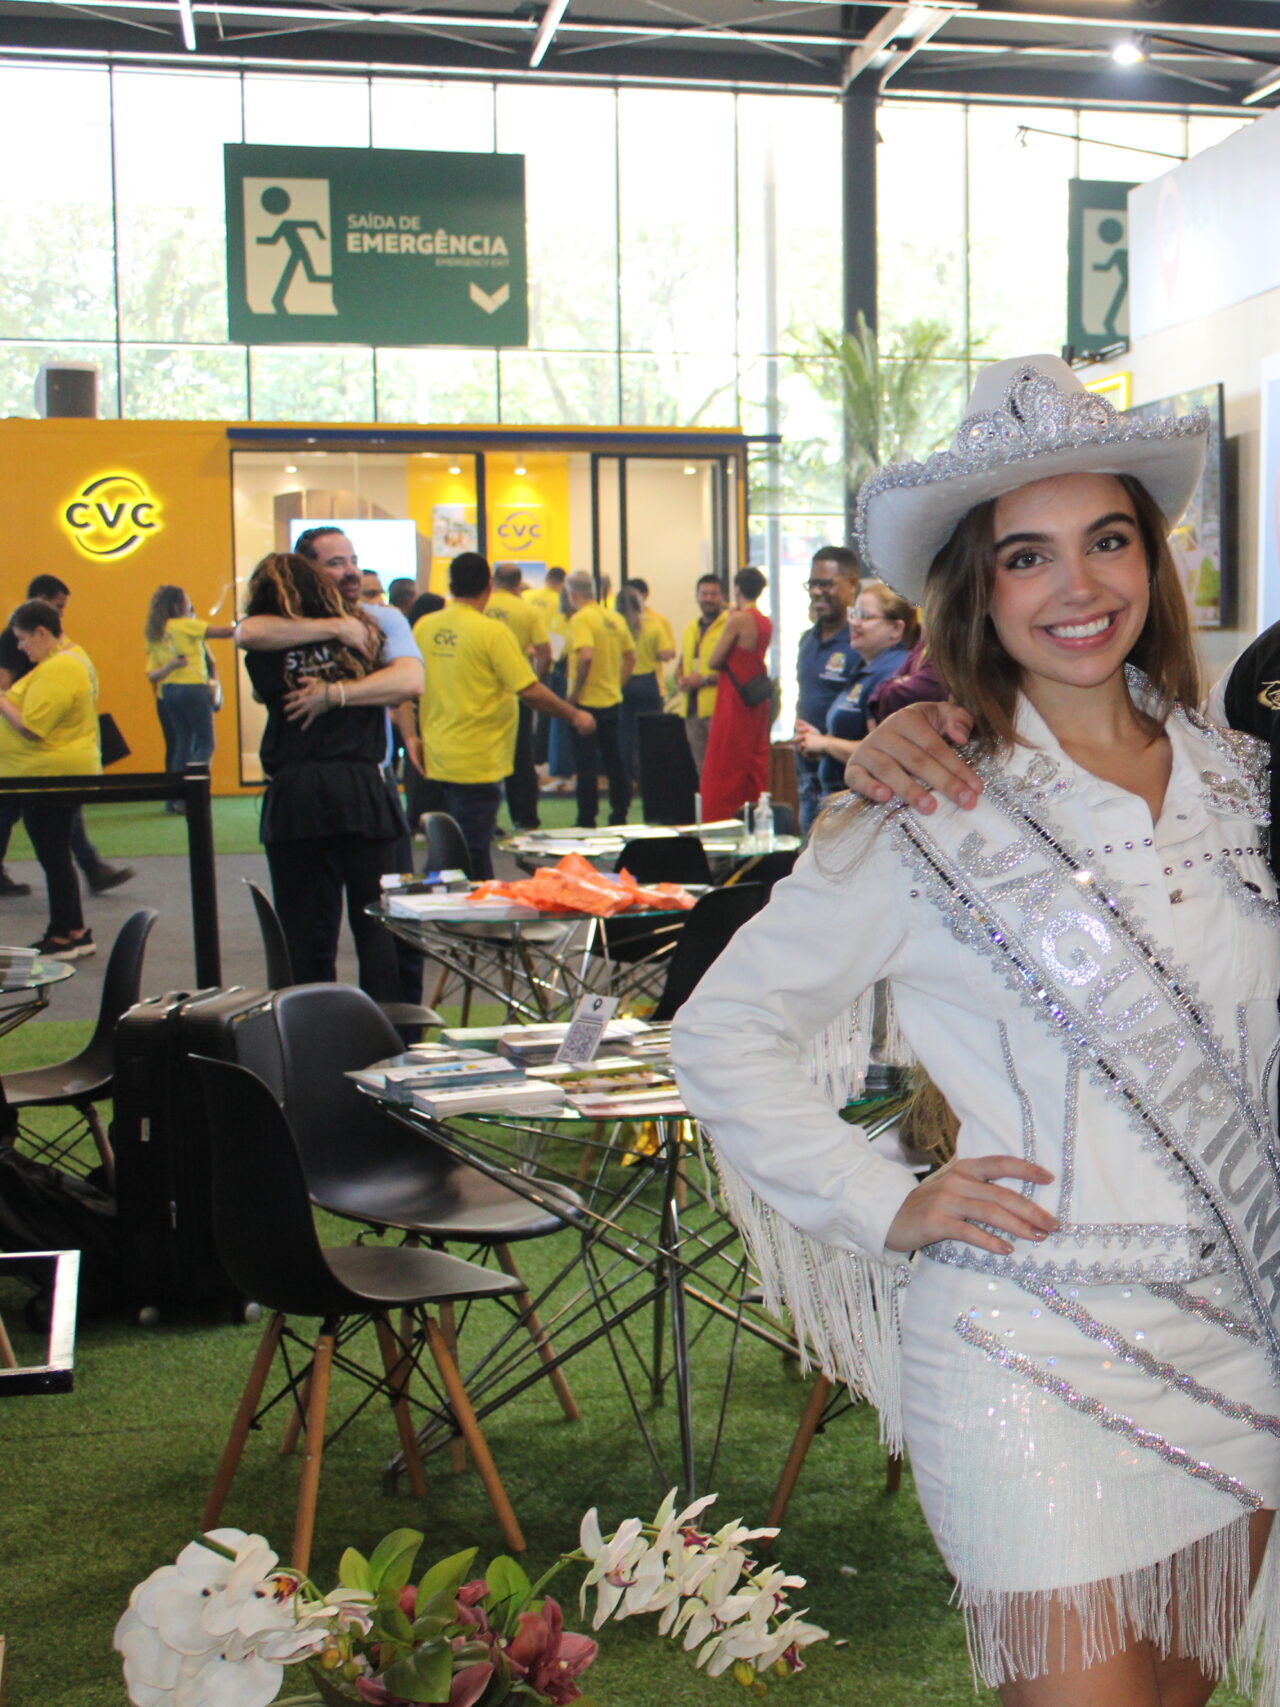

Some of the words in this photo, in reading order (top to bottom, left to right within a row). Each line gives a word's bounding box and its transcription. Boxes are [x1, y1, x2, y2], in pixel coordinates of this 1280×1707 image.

[347, 212, 396, 230] SAÍDA
[399, 215, 421, 231] DE
[347, 228, 509, 256] EMERGÊNCIA
[65, 502, 156, 529] CVC
[497, 524, 542, 538] CVC
[434, 632, 458, 647] CVC
